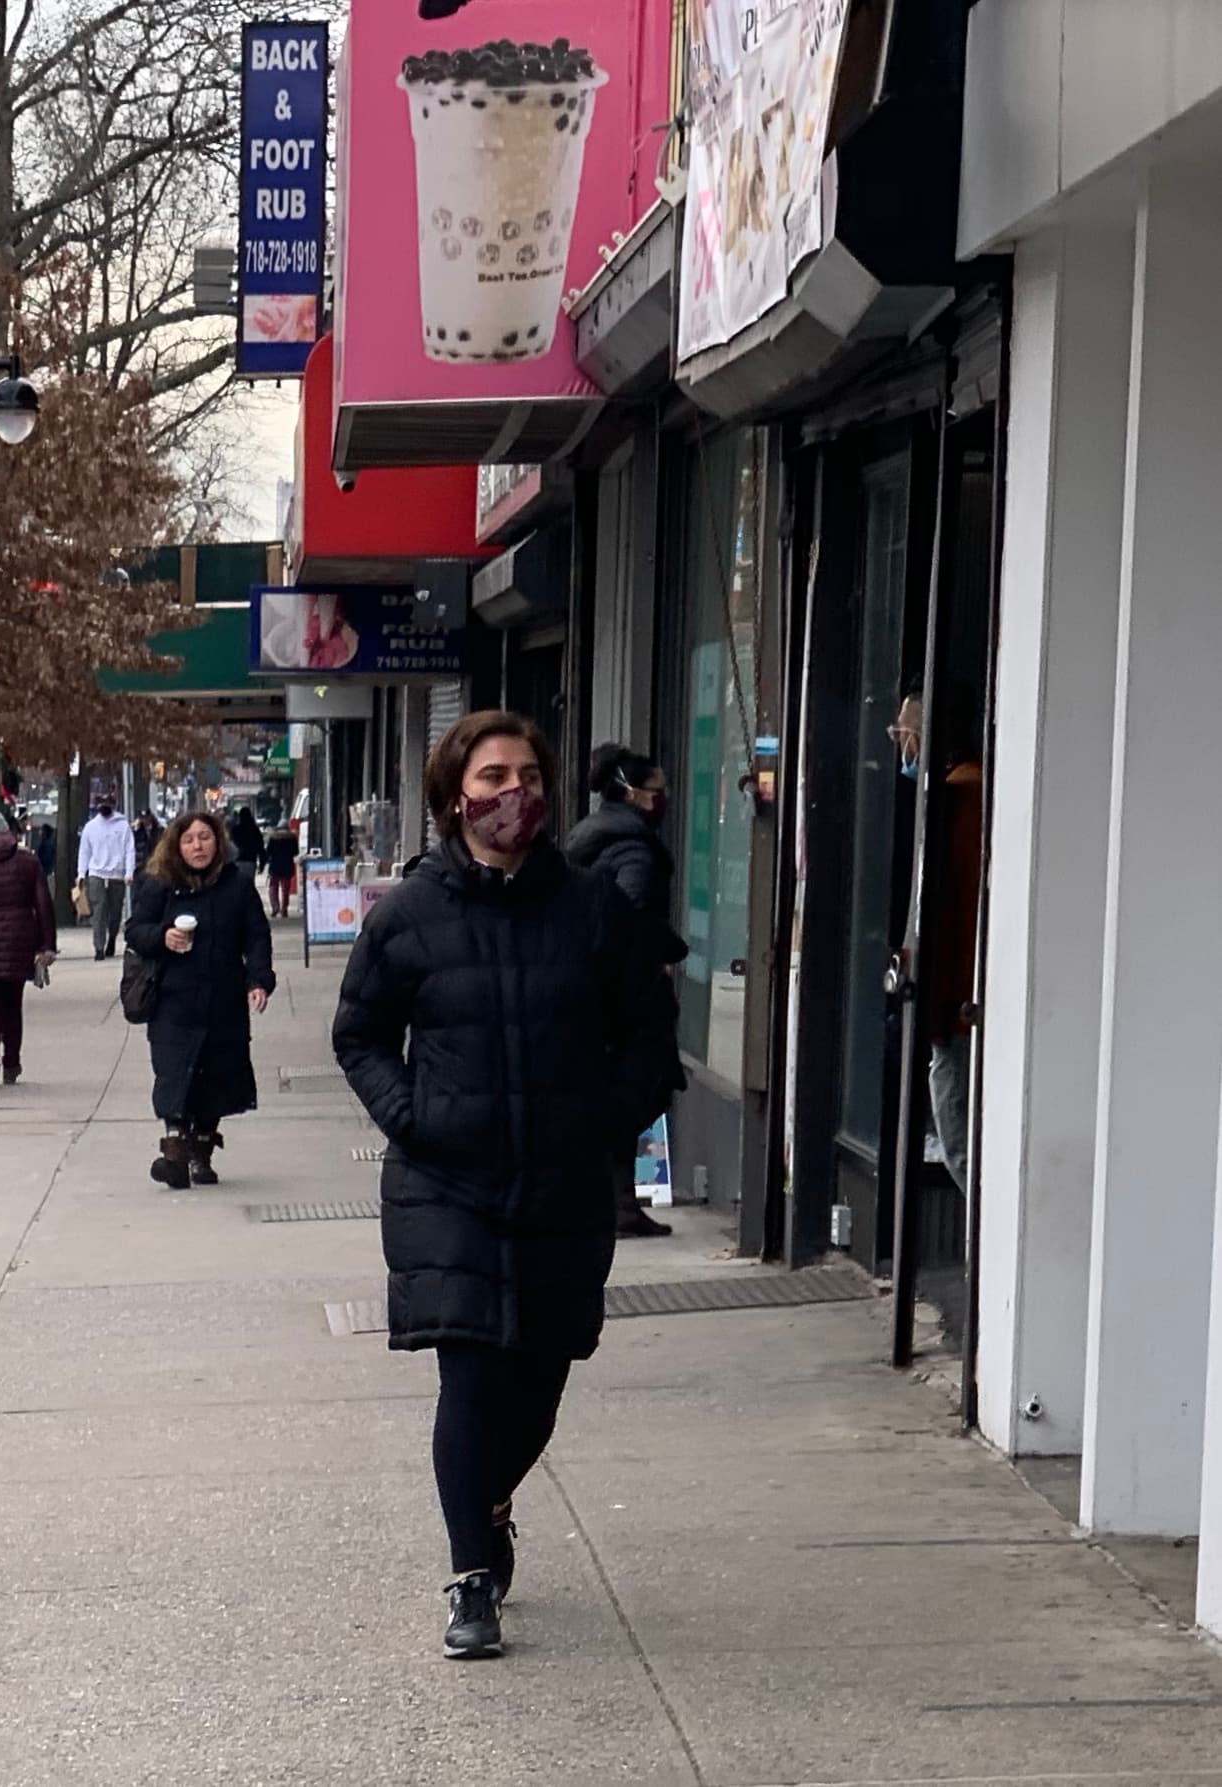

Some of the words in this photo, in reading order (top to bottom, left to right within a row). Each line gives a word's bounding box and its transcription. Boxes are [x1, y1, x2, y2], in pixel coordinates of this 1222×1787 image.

[251, 39, 318, 71] BACK
[274, 88, 292, 121] &
[250, 139, 315, 170] FOOT
[256, 189, 307, 220] RUB
[245, 240, 318, 274] 718-728-1918
[389, 638, 445, 650] RUB
